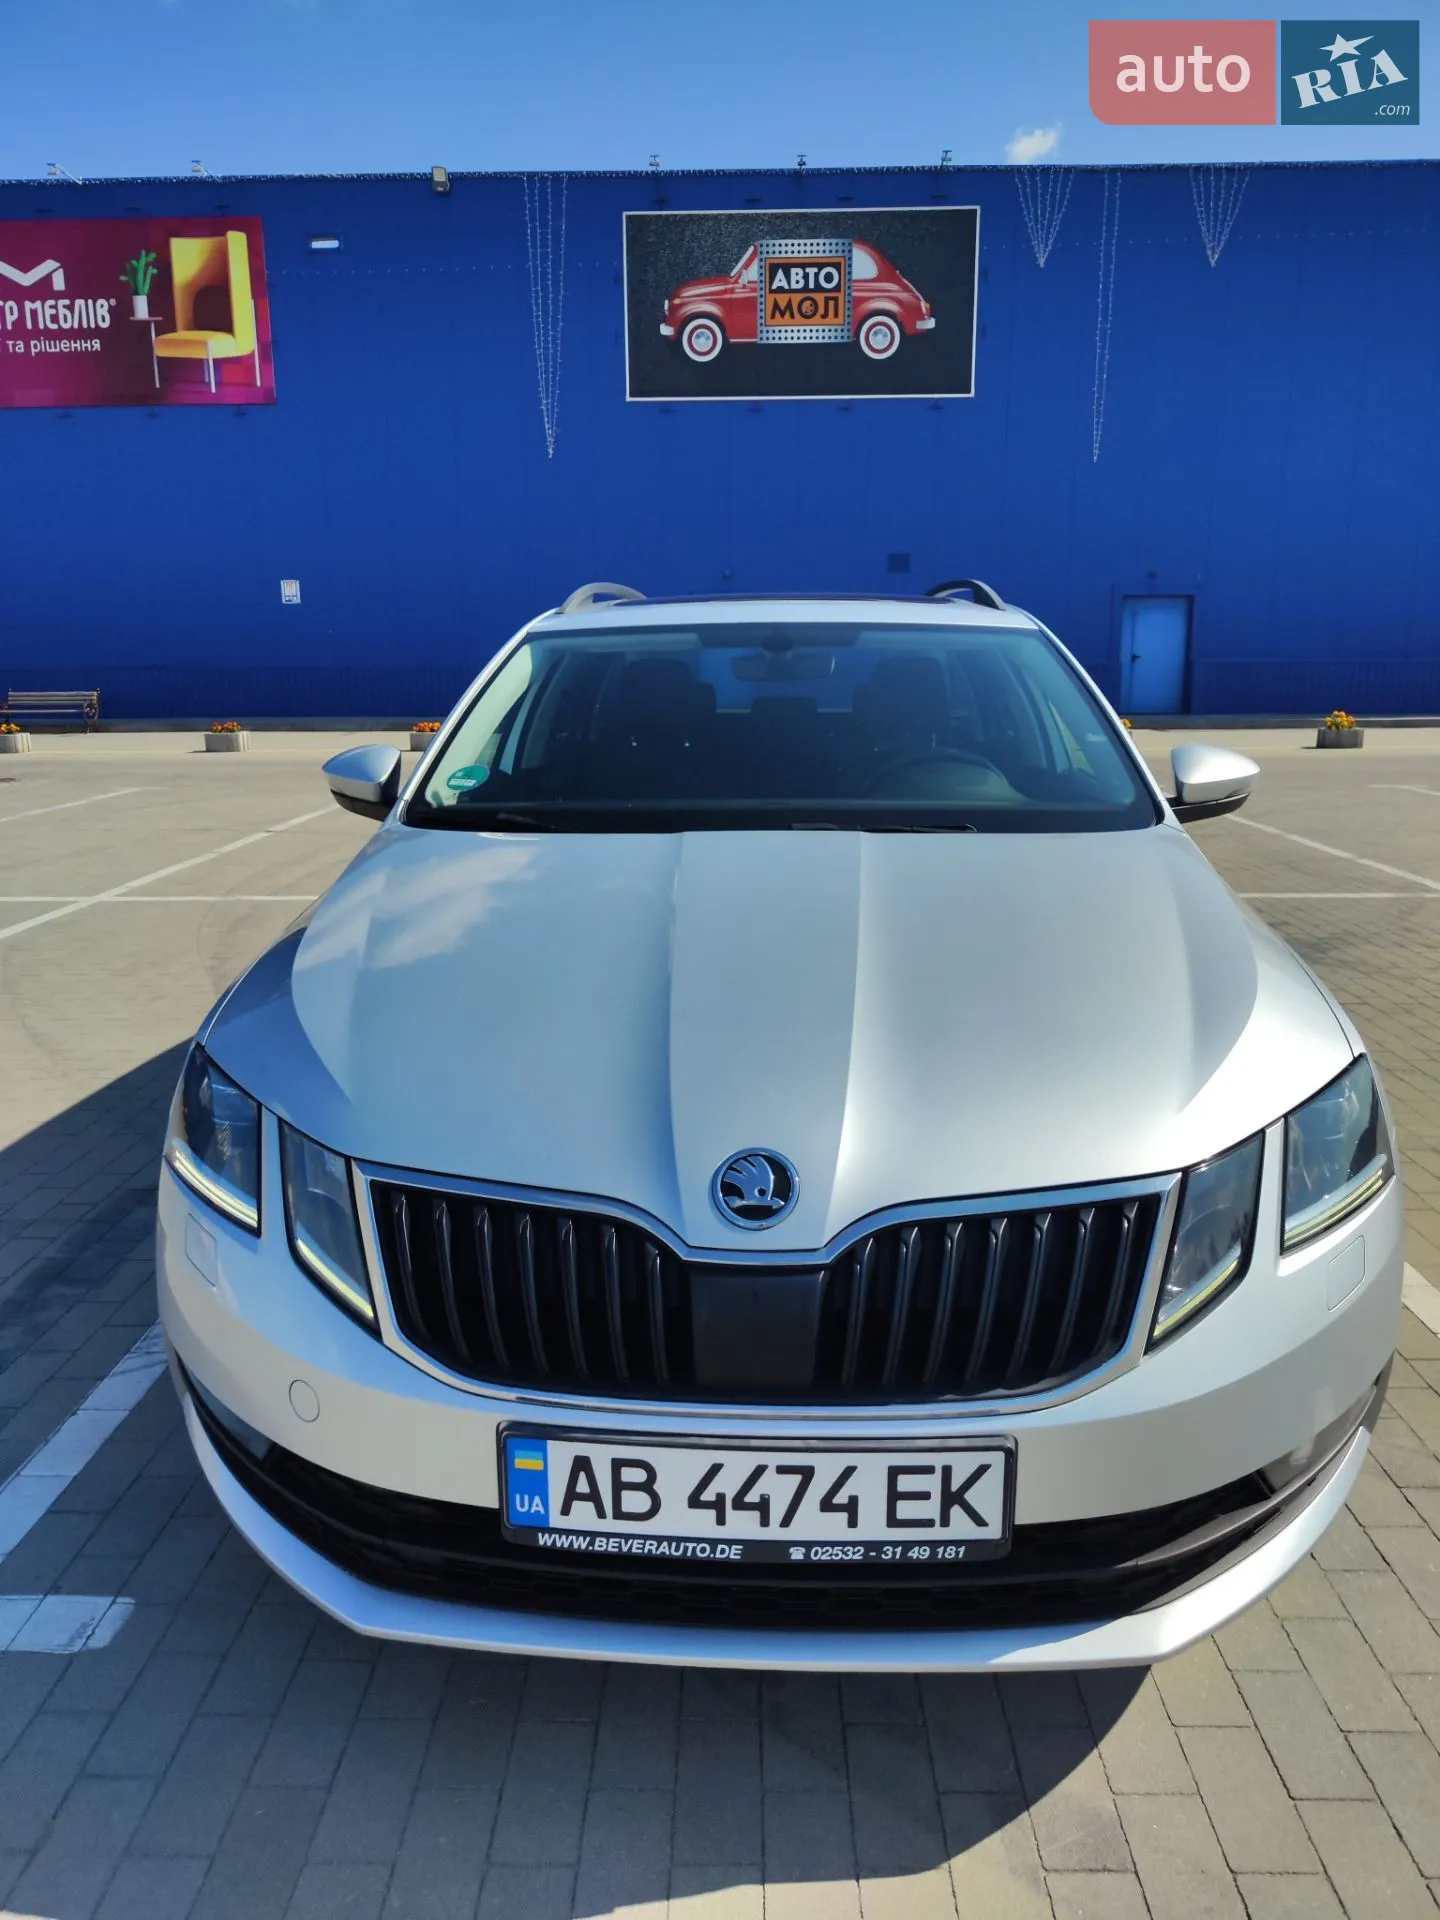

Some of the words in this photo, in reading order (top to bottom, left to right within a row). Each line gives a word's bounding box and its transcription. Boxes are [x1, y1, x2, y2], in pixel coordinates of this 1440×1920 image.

[771, 266, 840, 290] АВТО
[770, 296, 839, 320] МОЛ
[6, 340, 24, 353] та
[30, 336, 101, 357] рішення
[560, 1455, 662, 1522] AB
[687, 1462, 859, 1528] 4474
[886, 1464, 992, 1528] EK
[515, 1494, 545, 1514] UA
[538, 1532, 744, 1560] WWW.BEVERAUTO.DE
[810, 1546, 865, 1560] 02532
[881, 1546, 902, 1560] 31
[907, 1546, 930, 1560] 49
[936, 1545, 966, 1559] 181
